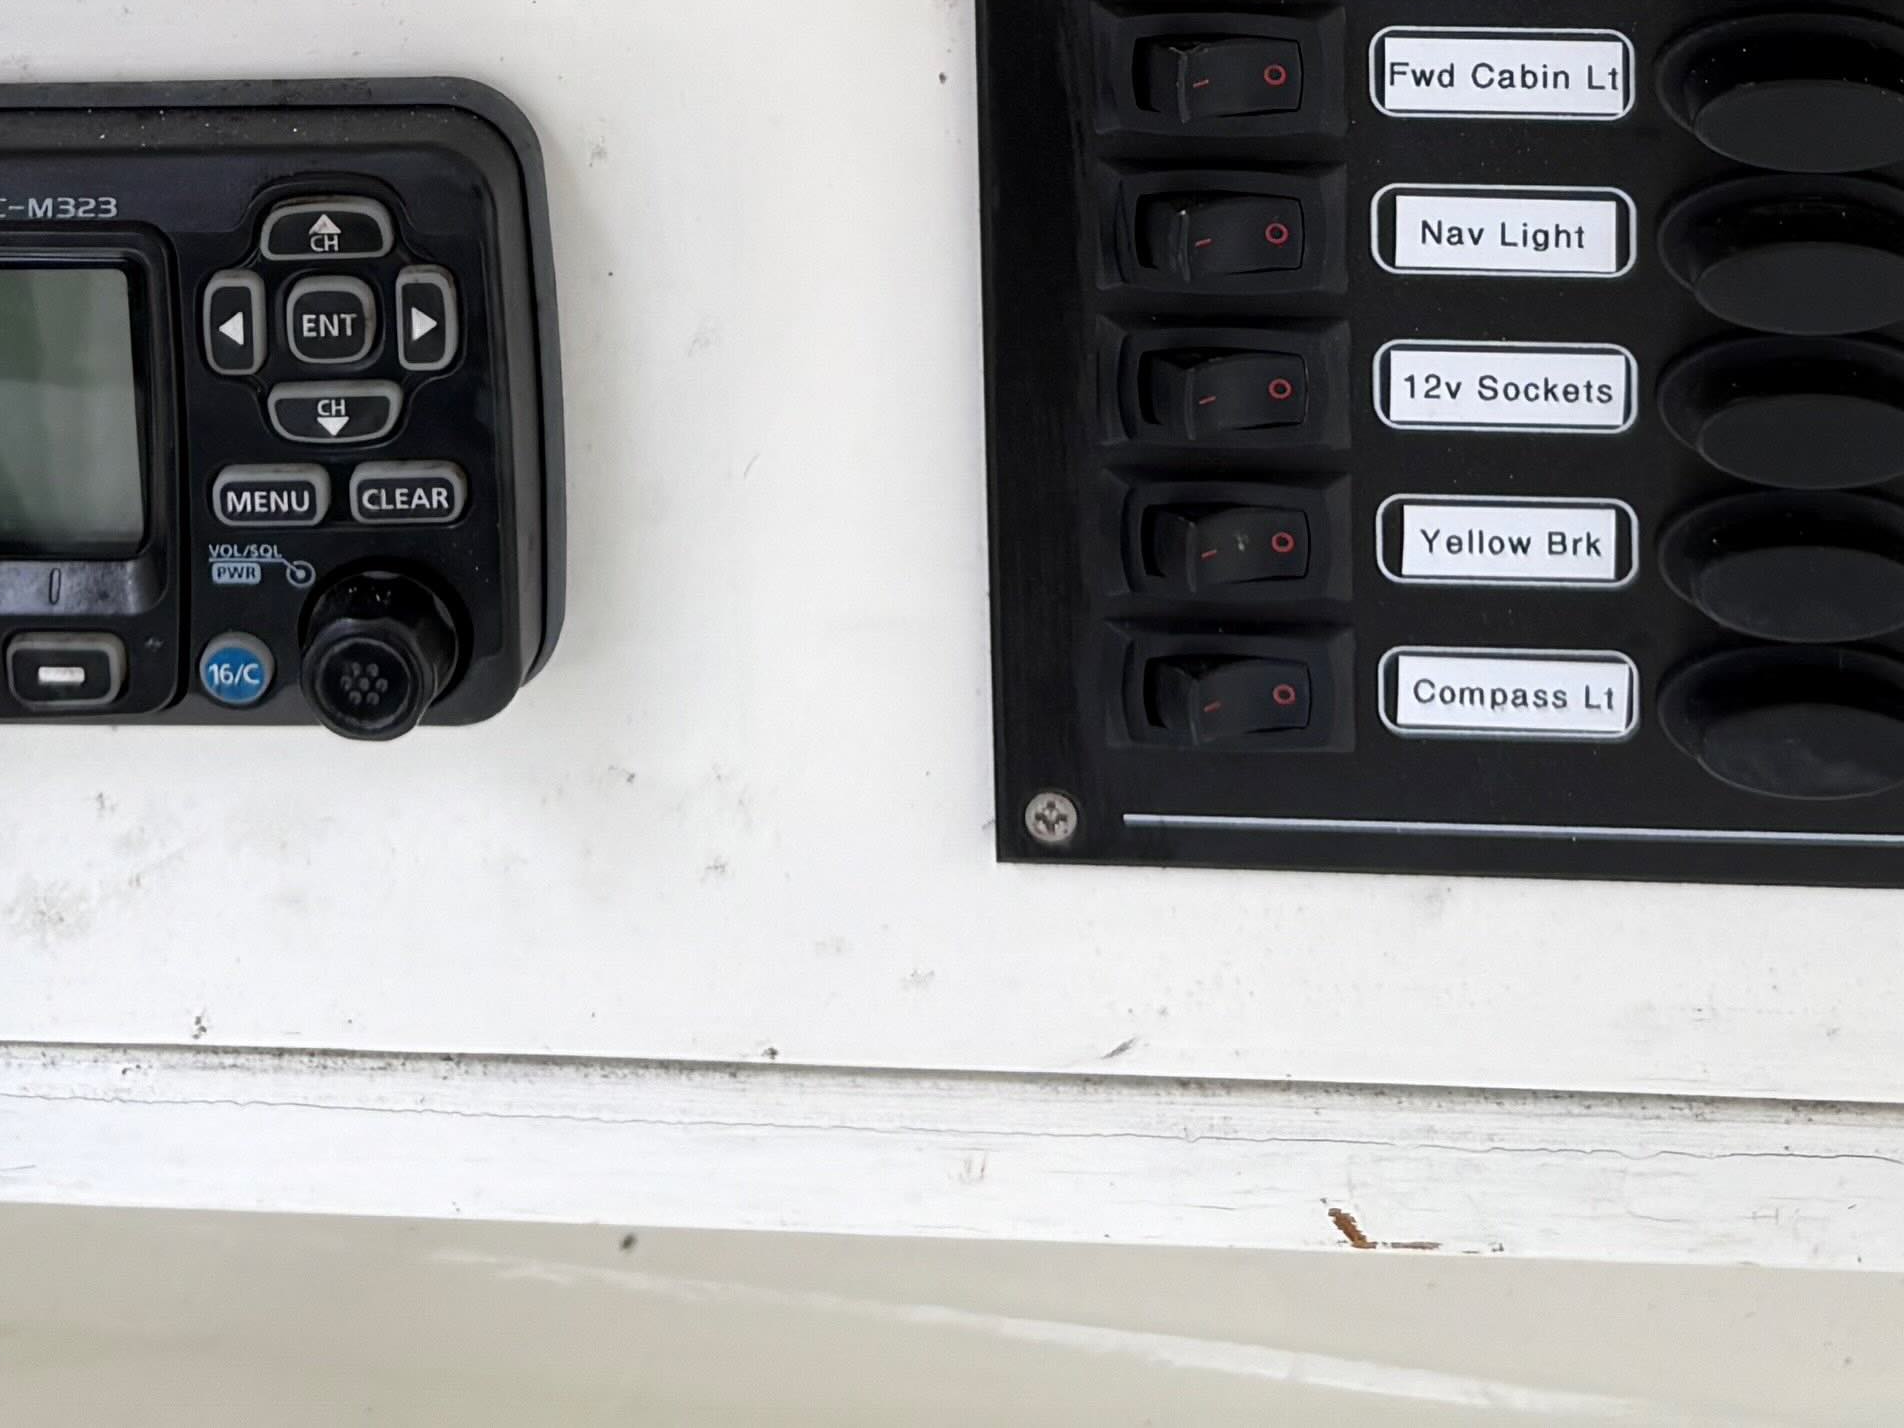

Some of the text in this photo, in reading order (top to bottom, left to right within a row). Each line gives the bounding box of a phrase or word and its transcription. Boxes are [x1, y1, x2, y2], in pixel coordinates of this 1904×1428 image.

[1389, 61, 1620, 91] Fwd Cabin Lt
[310, 235, 339, 252] CH
[1421, 219, 1585, 252] Nav Light
[302, 313, 357, 337] ENT
[1404, 373, 1613, 405] 12v Sockets
[317, 399, 345, 417] CH
[226, 490, 310, 513] MENU
[361, 487, 449, 510] CLEAR
[208, 543, 283, 557] VOL/SQL
[1420, 528, 1602, 557] Yellow Brk
[217, 565, 256, 580] PWR
[208, 663, 260, 686] 16/C
[1413, 678, 1614, 711] Compass Lt
